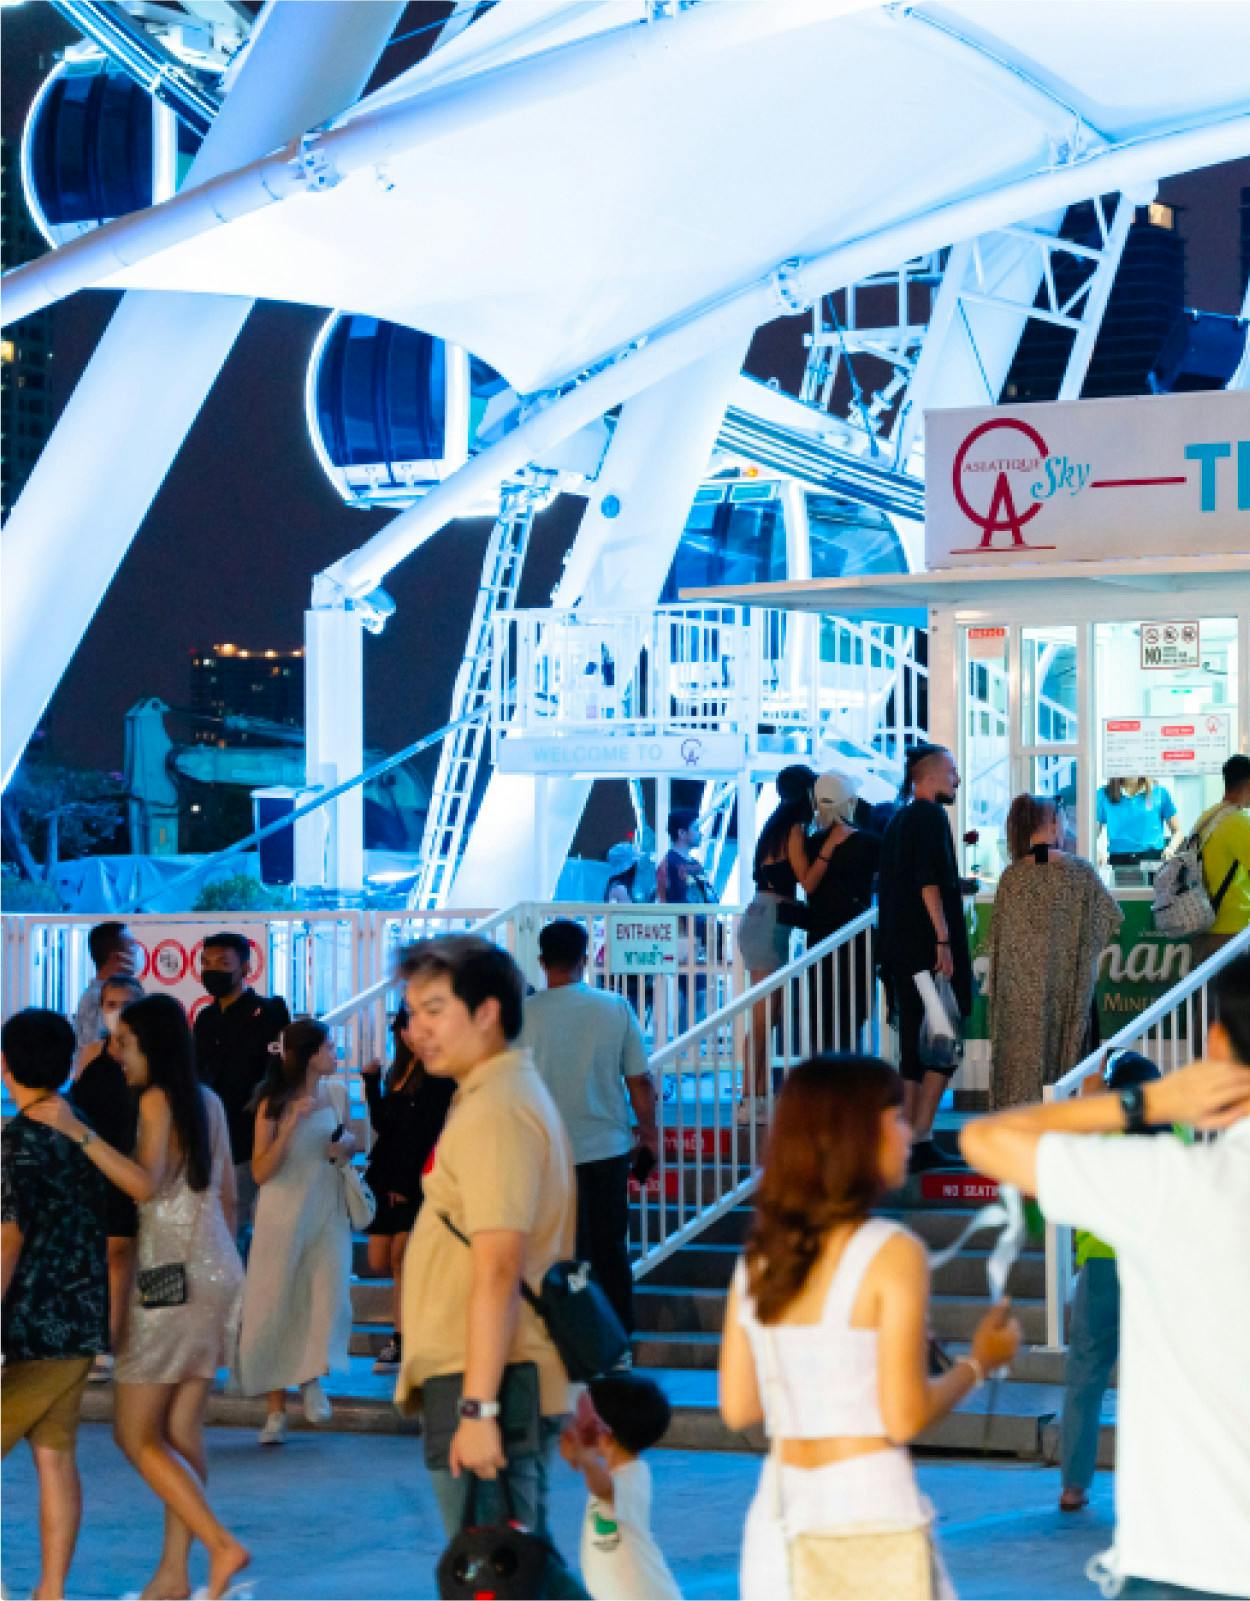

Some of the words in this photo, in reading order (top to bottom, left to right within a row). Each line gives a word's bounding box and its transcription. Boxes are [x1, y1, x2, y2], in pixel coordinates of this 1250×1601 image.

[1030, 456, 1090, 499] Sky
[1144, 646, 1161, 664] NO
[534, 744, 629, 763] WELCOME
[639, 743, 663, 761] TO
[616, 923, 672, 940] ENTRANCE
